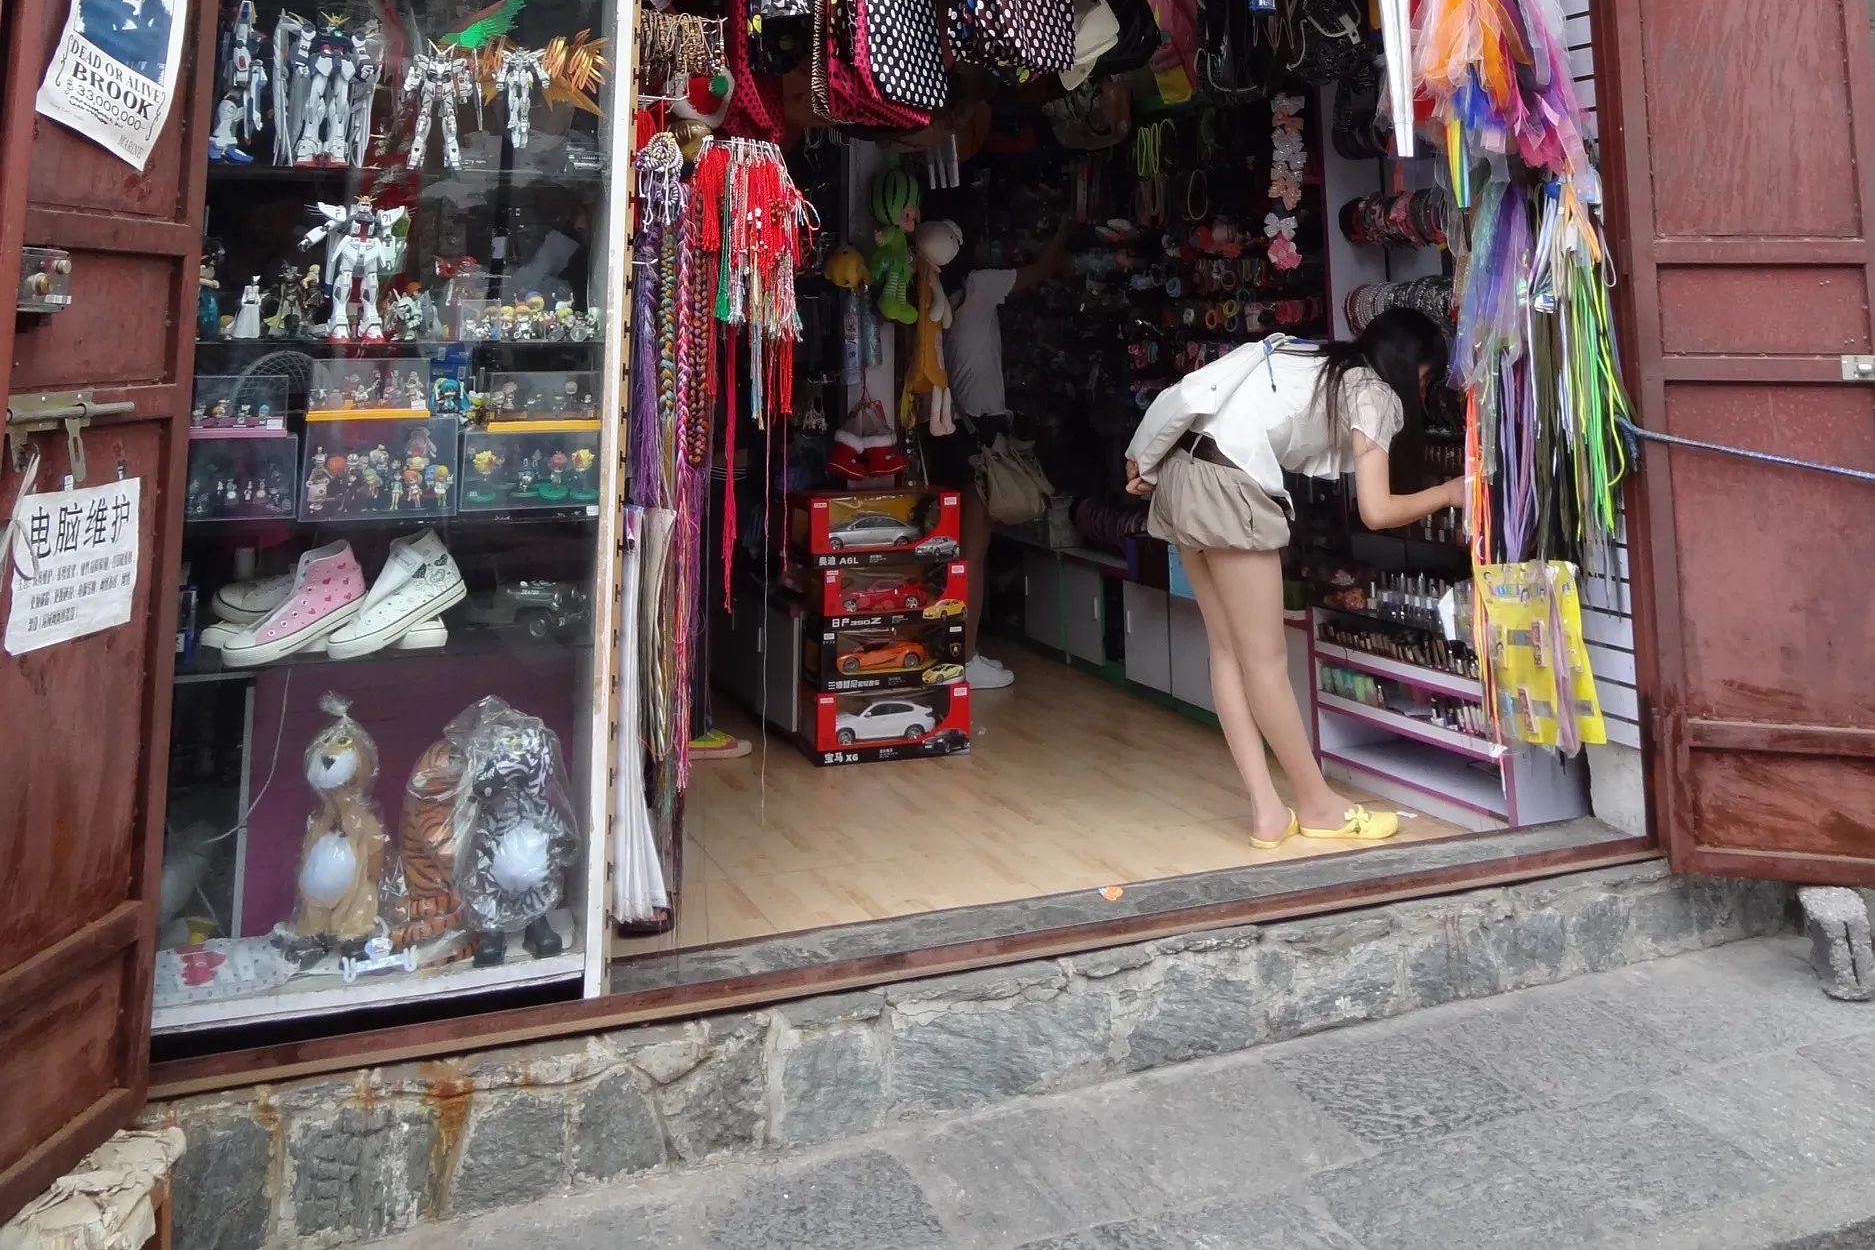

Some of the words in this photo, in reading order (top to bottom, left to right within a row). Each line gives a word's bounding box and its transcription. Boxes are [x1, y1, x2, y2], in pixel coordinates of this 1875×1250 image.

[70, 39, 102, 70] DEAD
[105, 62, 123, 83] OR
[126, 74, 160, 104] ALIVE
[71, 60, 154, 120] BROOK
[30, 494, 131, 559] 电脑维护
[839, 557, 859, 565] A6L
[824, 752, 843, 764] 宝马
[845, 753, 859, 762] X6
